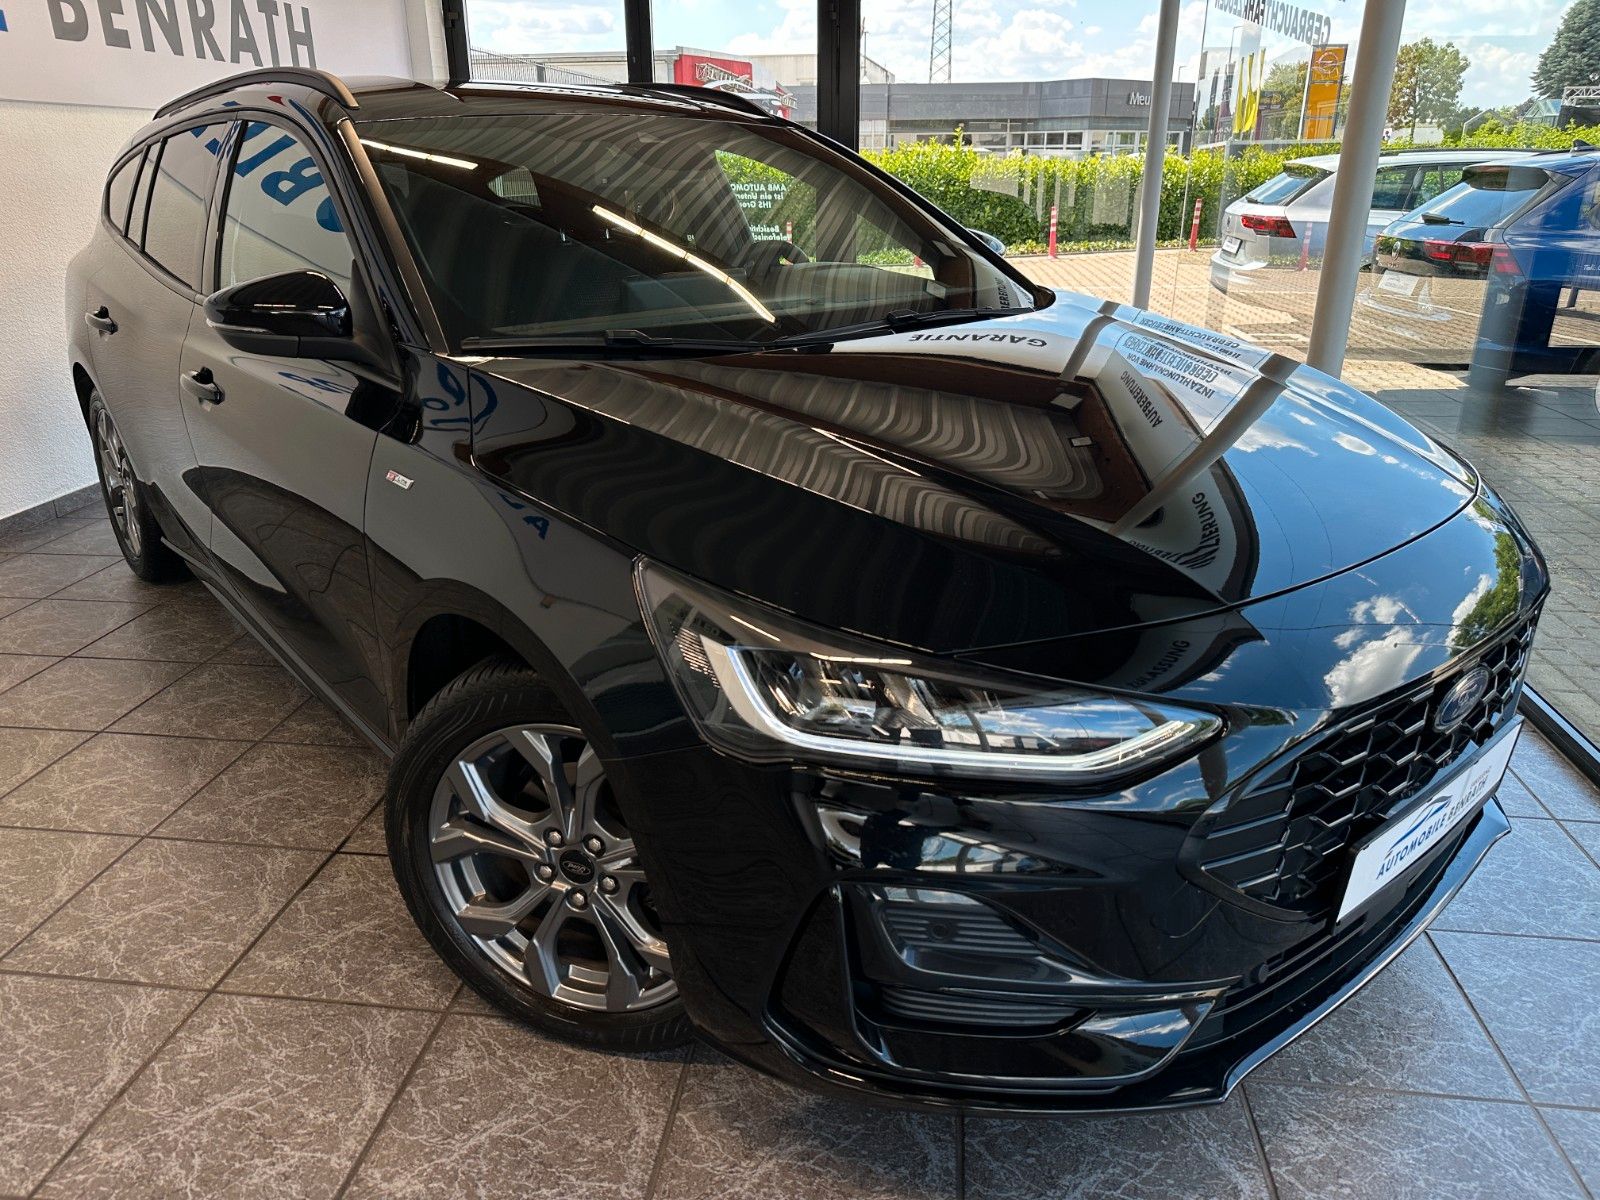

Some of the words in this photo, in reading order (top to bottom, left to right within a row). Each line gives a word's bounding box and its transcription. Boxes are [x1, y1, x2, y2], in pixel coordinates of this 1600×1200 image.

[47, 0, 318, 69] BENRATH
[1120, 370, 1163, 428] AUFBEREITUNG
[1376, 814, 1448, 880] AUTOMOBILE
